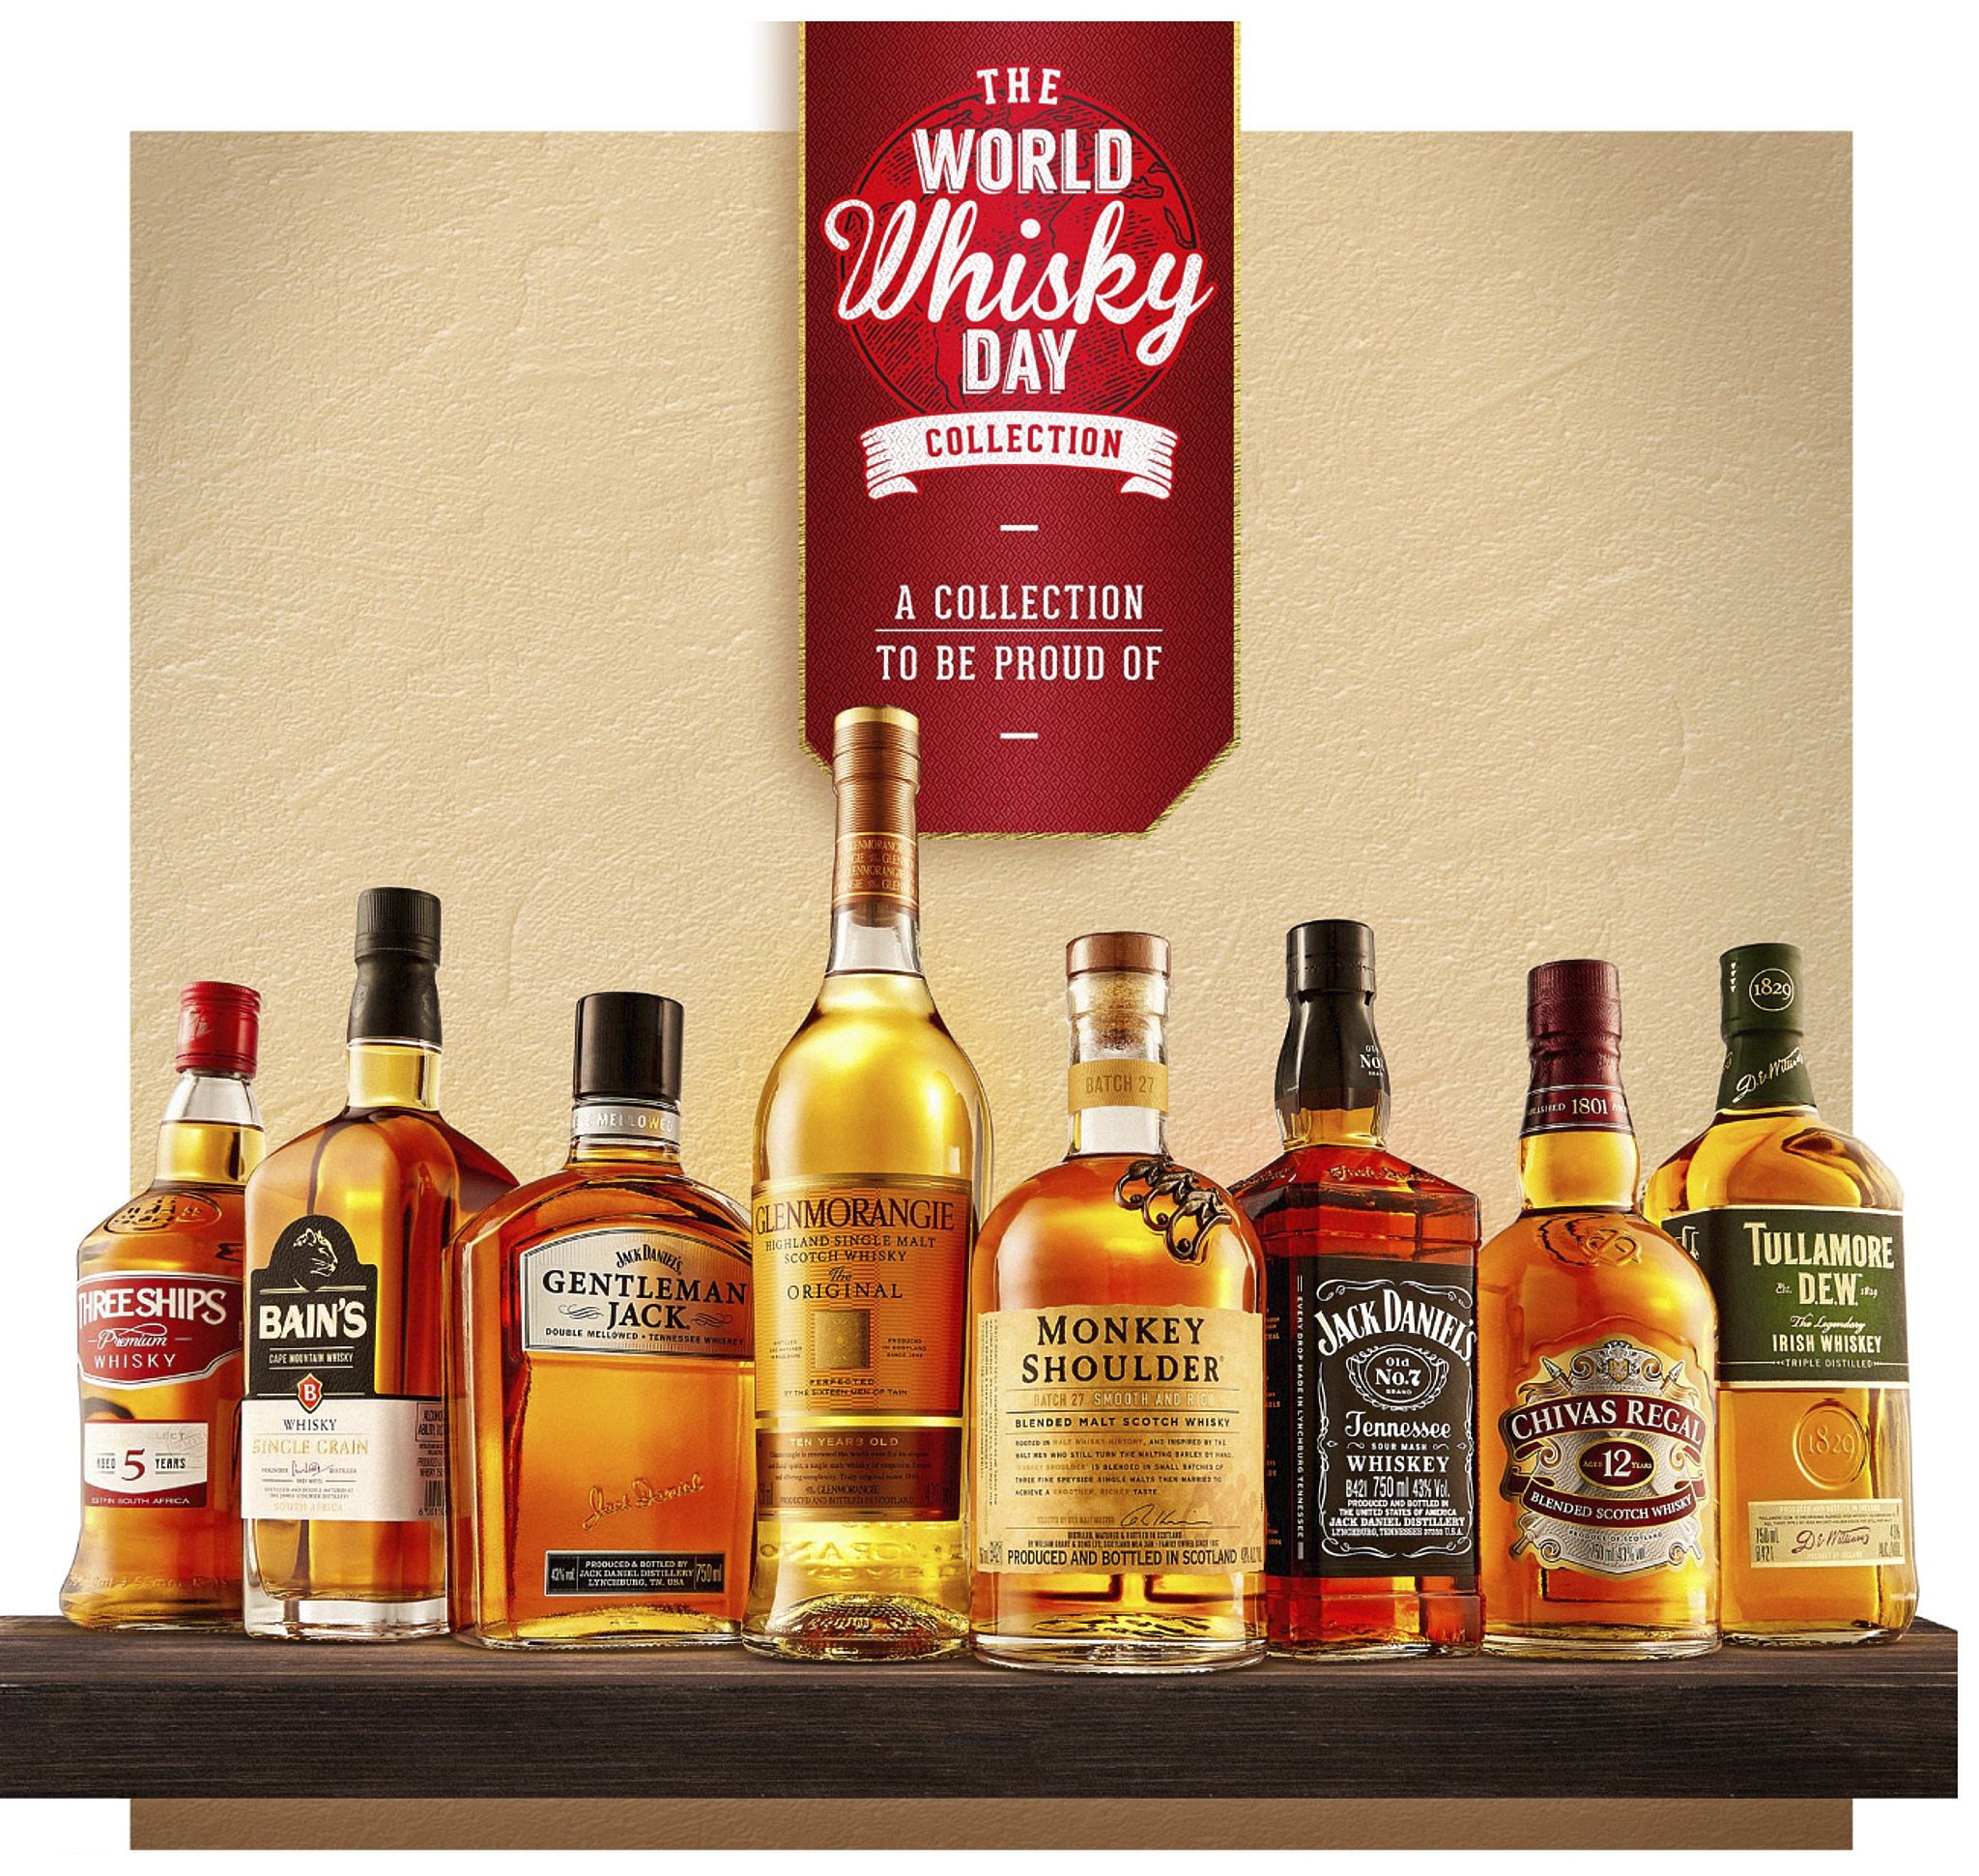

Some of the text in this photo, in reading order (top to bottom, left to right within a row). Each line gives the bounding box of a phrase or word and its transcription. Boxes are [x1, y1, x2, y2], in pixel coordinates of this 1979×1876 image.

[977, 67, 1061, 105] THE
[912, 129, 1133, 194] WORLD
[824, 198, 1215, 366] Whisky
[962, 328, 1077, 394] DAY
[925, 422, 1123, 459] COLLECTION
[894, 584, 1144, 621] A COLLECTION
[875, 645, 1162, 681] TO BE PROUD OF
[1753, 977, 1793, 1000] 1829
[1084, 1073, 1155, 1094] BATCH 27
[1571, 1097, 1608, 1116] 1801
[755, 1198, 955, 1235] GLENMORANGIE
[765, 1234, 936, 1252] HIGHLAND SINGLE MALT
[1742, 1222, 1895, 1269] TULLAMORE
[616, 1247, 643, 1269] JACK
[784, 1251, 907, 1264] SCOTCH WHISKY
[542, 1269, 748, 1305] GENTLEMAN
[787, 1284, 903, 1300] ORIGINAL
[1860, 1285, 1879, 1299] 1829
[78, 1286, 227, 1330] THREE SHIPS
[606, 1301, 688, 1331] JACK
[258, 1297, 368, 1340] BAIN'S
[1313, 1288, 1477, 1362] JACK DANIEL'S
[1790, 1313, 1867, 1334] The Legendary
[97, 1322, 168, 1350] Premium
[545, 1327, 584, 1338] DOUBLE
[587, 1329, 639, 1341] MELLOWED
[648, 1333, 702, 1344] TENNESSEE
[1037, 1314, 1205, 1346] MONKEY
[1772, 1334, 1882, 1354] IRISH WHISKEY
[94, 1353, 176, 1369] WHISKY
[269, 1353, 287, 1364] CAPE
[327, 1352, 354, 1363] WHISKY
[1385, 1356, 1410, 1368] Old
[1785, 1358, 1875, 1369] TRIPLE DISTILLED
[1021, 1353, 1219, 1384] SHOULDER
[303, 1383, 317, 1400] B
[809, 1377, 875, 1387] PERFECTED
[812, 1388, 849, 1397] SIXTEEN
[887, 1388, 908, 1397] TAIN
[1033, 1392, 1067, 1407] BATCH
[1070, 1392, 1085, 1407] 27
[1093, 1392, 1149, 1407] SMOOTH
[1155, 1392, 1181, 1407] AND
[1297, 1396, 1304, 1407] IN
[282, 1418, 337, 1431] WHISKY
[1015, 1417, 1231, 1429] BLENDED MALT SCOTCH WHISKY
[1344, 1409, 1452, 1438] Tennessee
[1511, 1399, 1703, 1447] CHIVAS REGAL
[251, 1438, 369, 1456] SINGLE GRAIN
[789, 1437, 900, 1447] TEN YEARS OLD
[1148, 1438, 1165, 1447] AND
[1808, 1425, 1856, 1462] 1829
[1050, 1451, 1068, 1459] WHO
[1070, 1451, 1094, 1459] STILL
[1095, 1451, 1117, 1459] TURN
[1120, 1451, 1136, 1459] THE
[1138, 1451, 1172, 1459] MALTING
[1346, 1455, 1450, 1473] WHISKEY
[1602, 1449, 1632, 1478] 12
[121, 1448, 146, 1482] 5
[154, 1457, 186, 1469] YEARS
[1372, 1475, 1394, 1498] 750
[1339, 1508, 1457, 1516] THE UNITED STATES OF AMERICA
[1347, 1499, 1449, 1508] PRODUCED AND BOTTLED IN
[1530, 1490, 1693, 1520] BLENDED SCOTCH WHISKY
[1329, 1516, 1466, 1527] JACK DANIEL DISTILLERY
[1379, 1527, 1423, 1537] TENNESSEE
[585, 1560, 631, 1569] PRODUCED
[640, 1560, 676, 1569] BOTTLED
[677, 1560, 689, 1569] BY
[1007, 1549, 1068, 1566] PRODUCED
[1070, 1549, 1099, 1566] AND
[1102, 1549, 1162, 1566] BOTTLED
[1165, 1549, 1179, 1566] IN
[1182, 1549, 1238, 1566] SCOTLAND
[580, 1570, 694, 1578] JACK DANIEL DISTILLERY
